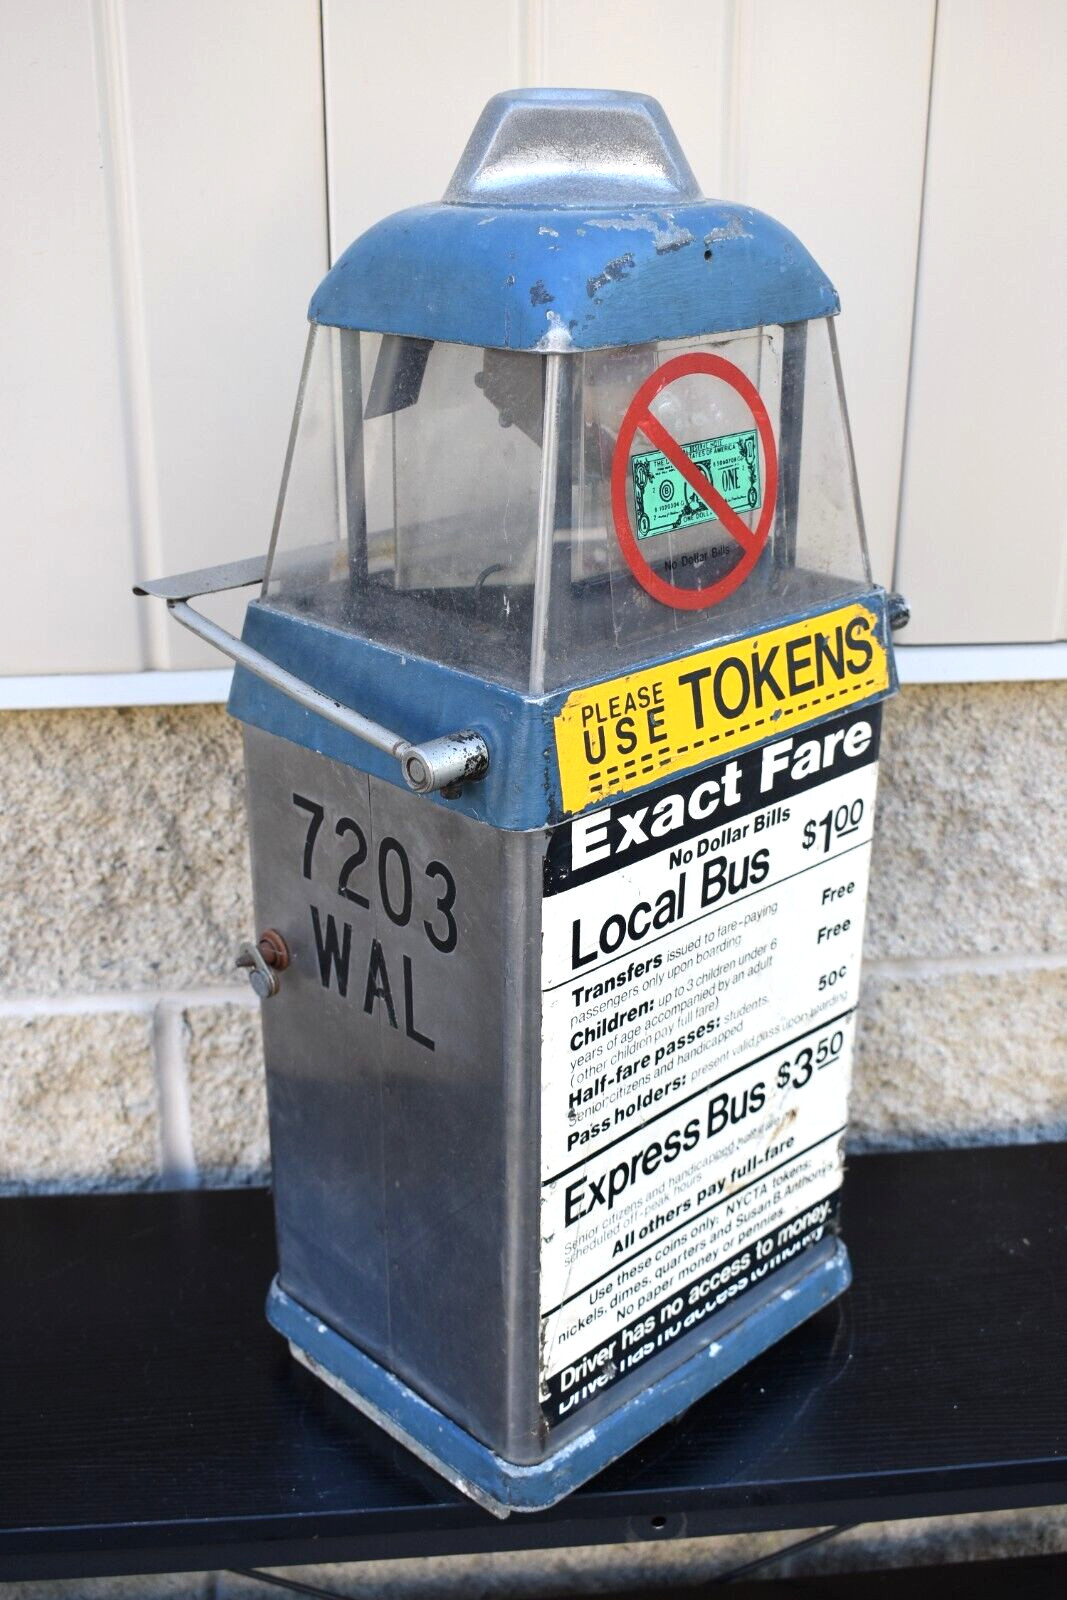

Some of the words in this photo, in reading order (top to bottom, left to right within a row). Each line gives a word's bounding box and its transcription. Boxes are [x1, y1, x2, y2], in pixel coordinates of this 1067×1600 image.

[722, 467, 741, 492] ONE
[664, 560, 678, 571] No
[681, 551, 708, 567] Dollar
[711, 545, 730, 558] Bills
[581, 681, 665, 728] PLEASE
[678, 616, 875, 730] TOKENS
[582, 705, 668, 765] USE
[571, 763, 743, 872] Exact
[759, 720, 873, 794] Fare
[669, 848, 693, 871] No
[696, 824, 750, 860] Dollar
[753, 806, 791, 834] Bills
[292, 792, 458, 954] 7203
[571, 871, 687, 971] Local
[700, 847, 771, 909] Bus
[821, 881, 856, 906] Free
[310, 904, 435, 1052] WAL
[571, 953, 663, 1008] Transfers
[666, 935, 701, 963] issued
[704, 931, 715, 945] to
[717, 902, 779, 938] fare-paying
[816, 918, 851, 945] Free
[570, 984, 639, 1030] passengers
[642, 971, 666, 992] only
[667, 957, 694, 984] upon
[696, 934, 743, 965] boarding
[570, 999, 655, 1052] Children:
[658, 989, 672, 1008] up
[674, 985, 685, 999] to
[686, 978, 694, 992] 3
[695, 958, 736, 987] children
[738, 943, 768, 966] under
[770, 937, 778, 950] 6
[570, 1045, 603, 1073] years
[606, 1034, 618, 1051] of
[620, 1025, 642, 1045] age
[644, 983, 716, 1031] accompanied
[718, 978, 730, 992] by
[732, 970, 745, 985] an
[747, 954, 773, 977] adult
[568, 1054, 651, 1108] Half-fare
[654, 1016, 721, 1066] passes:
[609, 1075, 651, 1104] citizens
[653, 1059, 674, 1079] and
[677, 1020, 744, 1067] handicapped
[610, 1037, 652, 1065] children
[654, 1025, 674, 1045] pay
[677, 1009, 693, 1029] full
[695, 996, 719, 1019] fare)
[567, 1116, 611, 1153] Pass
[614, 1074, 687, 1126] holders:
[691, 1050, 730, 1083] present
[732, 1035, 755, 1057] valid
[755, 1025, 781, 1046] pass
[565, 1118, 701, 1229] Express
[707, 1081, 766, 1139] Bus
[612, 1230, 635, 1258] All
[638, 1199, 692, 1240] others
[696, 1176, 727, 1206] pay
[730, 1136, 795, 1184] full-fare
[564, 1225, 599, 1255] Senior
[602, 1197, 643, 1229] citizens
[645, 1183, 666, 1203] and
[564, 1224, 620, 1268] scheduled
[673, 1173, 702, 1197] hours
[589, 1281, 613, 1305] Use
[616, 1257, 652, 1286] these
[654, 1233, 688, 1262] coins
[726, 1183, 768, 1217] NYCTA
[654, 1239, 707, 1279] quarters
[709, 1222, 732, 1245] and
[735, 1200, 772, 1229] Susan
[560, 1340, 618, 1393] Driver
[621, 1315, 656, 1350] has
[660, 1296, 684, 1324] no
[688, 1252, 751, 1305] access
[755, 1237, 774, 1261] to
[777, 1199, 833, 1247] money.
[616, 1304, 634, 1323] No
[637, 1278, 674, 1310] paper
[677, 1249, 723, 1281] money
[722, 1237, 735, 1253] or
